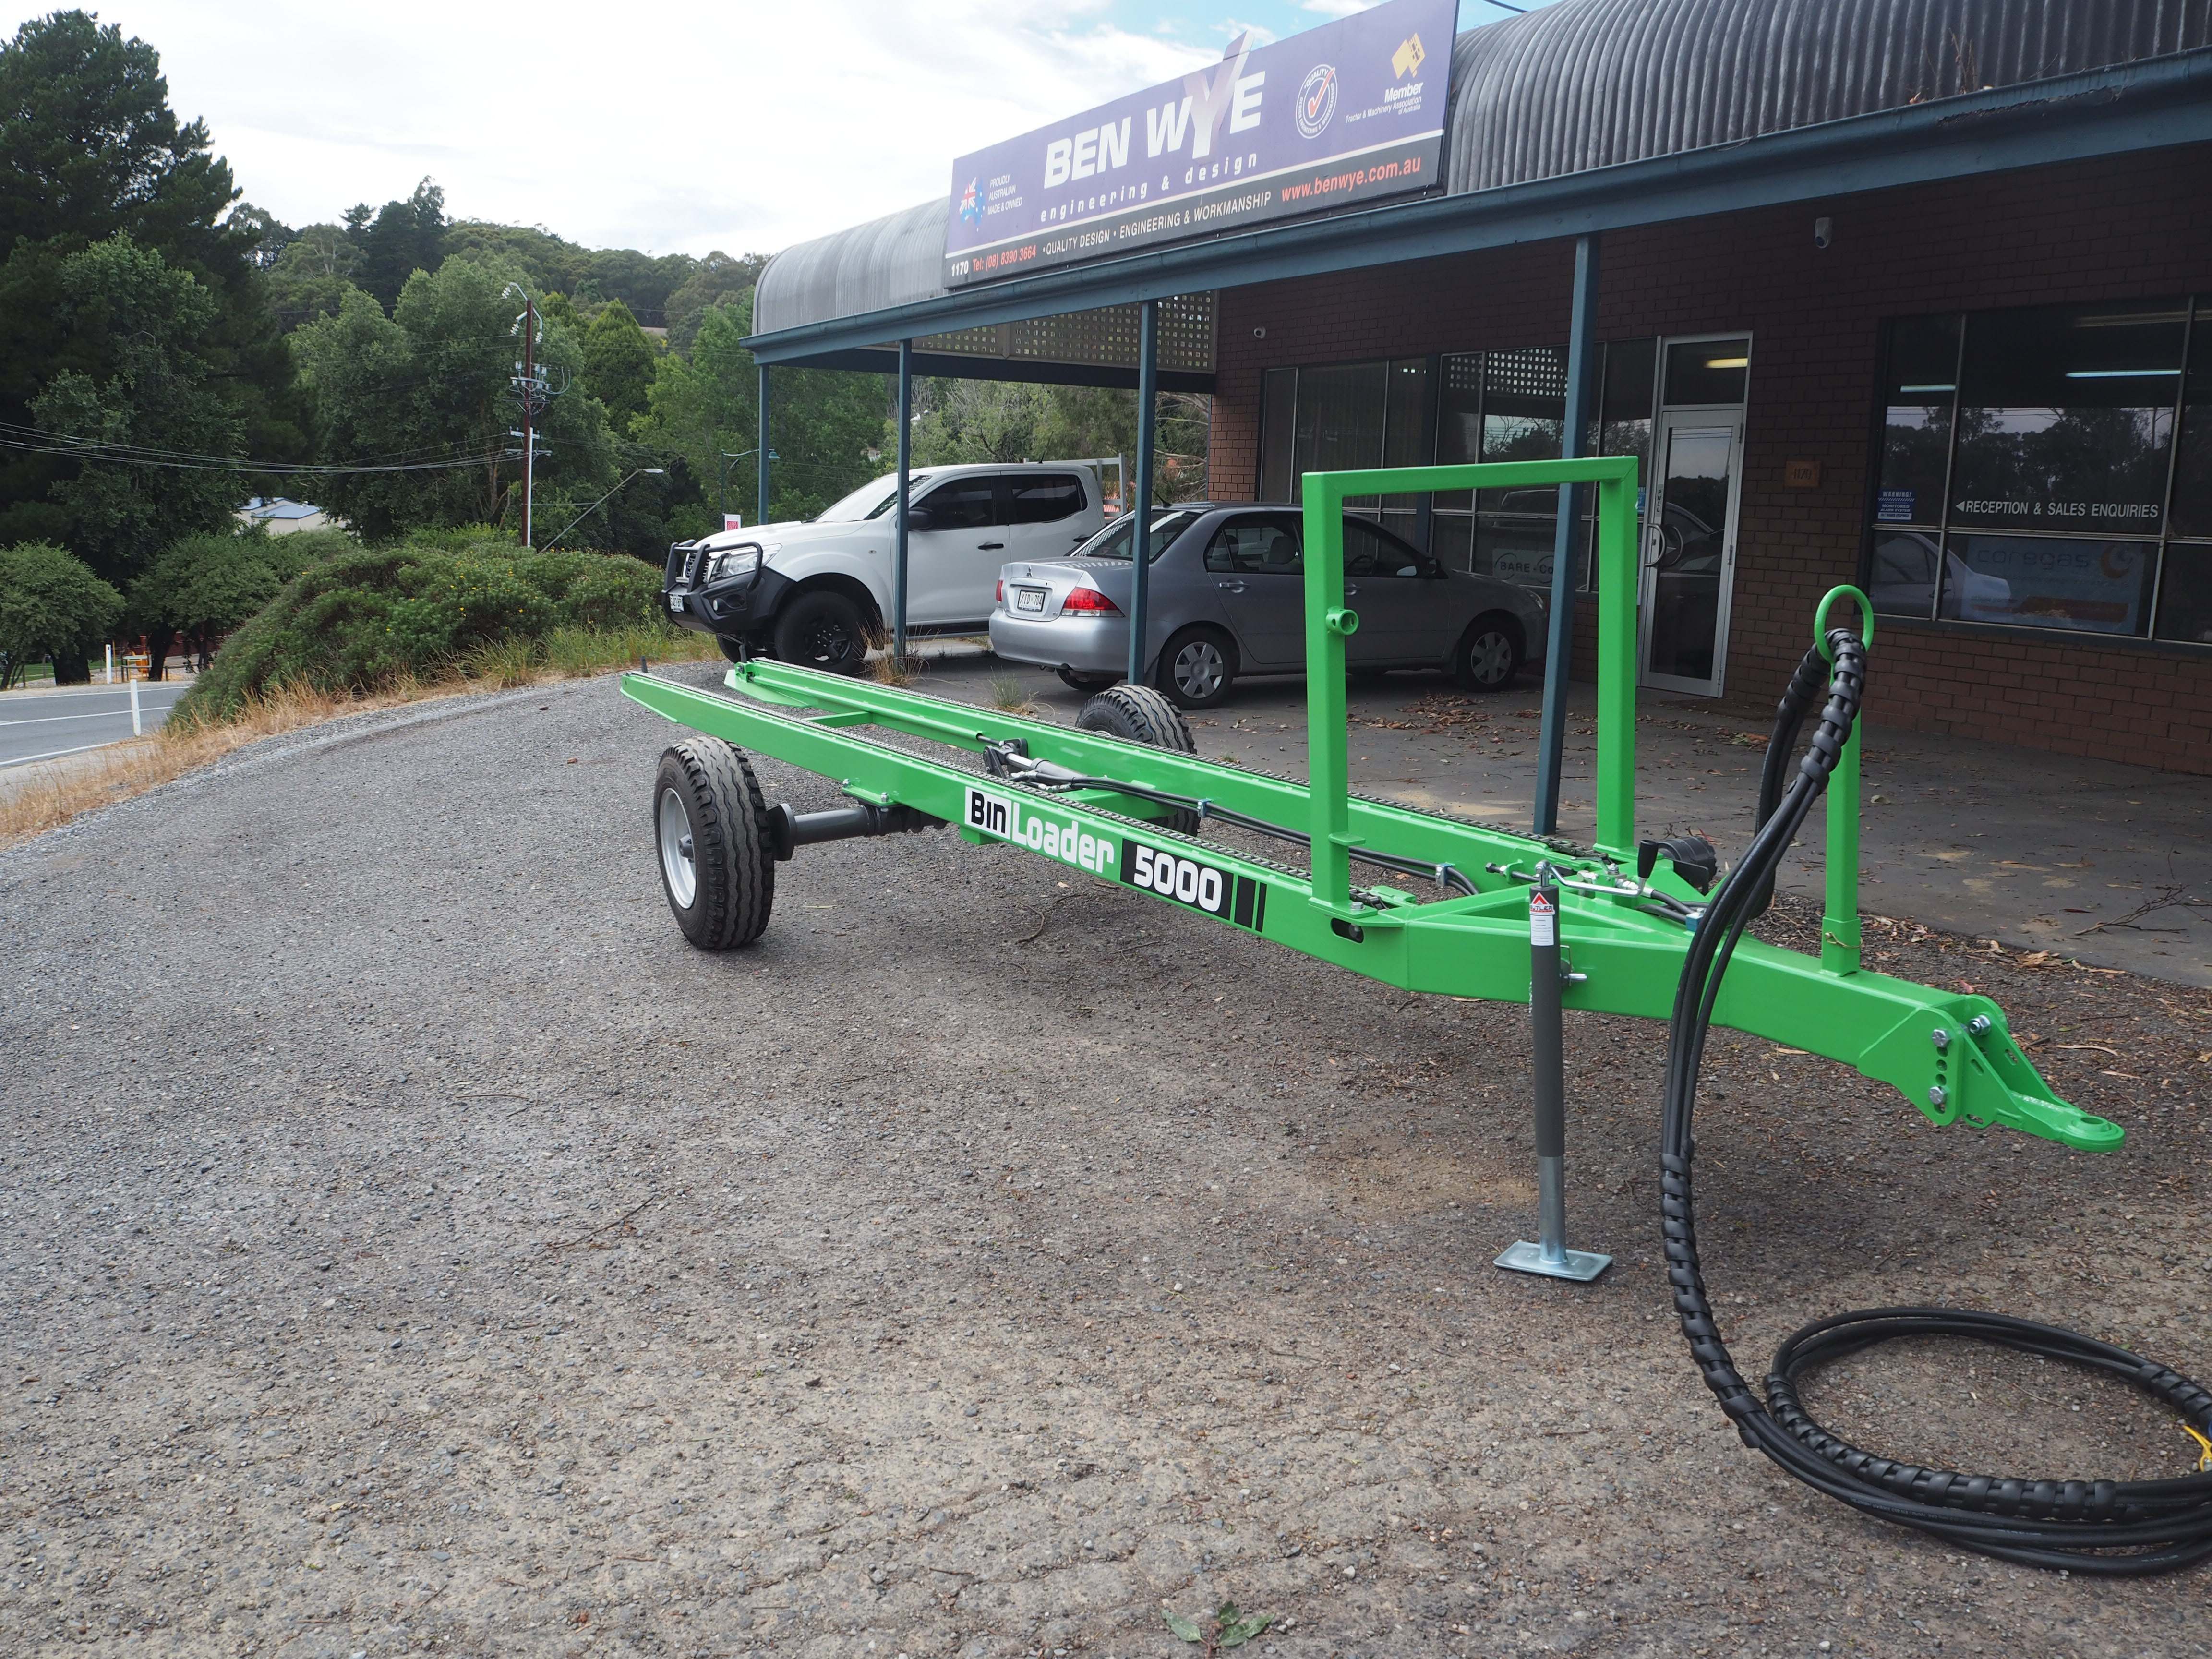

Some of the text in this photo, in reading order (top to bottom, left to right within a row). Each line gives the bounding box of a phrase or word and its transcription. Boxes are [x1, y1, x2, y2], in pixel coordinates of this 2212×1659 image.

[1305, 68, 1329, 88] QUALITY
[1384, 82, 1423, 103] Member
[1044, 29, 1265, 189] BEN WYE
[1346, 113, 1361, 123] Tractor
[1367, 104, 1392, 117] Machinery
[1392, 96, 1422, 110] Association
[1403, 104, 1421, 114] Australia
[990, 174, 1011, 188] PROUDLY
[1041, 153, 1257, 222] engineering & design
[989, 185, 1016, 201] AUSTRALIAN
[951, 260, 969, 277] 1170
[973, 258, 984, 272] Tel:
[986, 255, 999, 271] (08)
[1001, 250, 1018, 265] 8390
[1019, 245, 1036, 261] 3664
[1080, 229, 1110, 248] DESIGN
[1120, 212, 1181, 239] ENGINEERING
[1184, 210, 1190, 222] &
[1194, 191, 1271, 222] WORKMANSHIP
[1281, 156, 1422, 202] www.benwye.com.au
[987, 197, 1022, 216] MADE & OWNED
[1966, 500, 2159, 519] RECEPTION & SALES ENQUIRIES
[1978, 549, 2089, 570] coregas
[1020, 593, 1043, 606] XID 704
[1133, 844, 1223, 912] 5000
